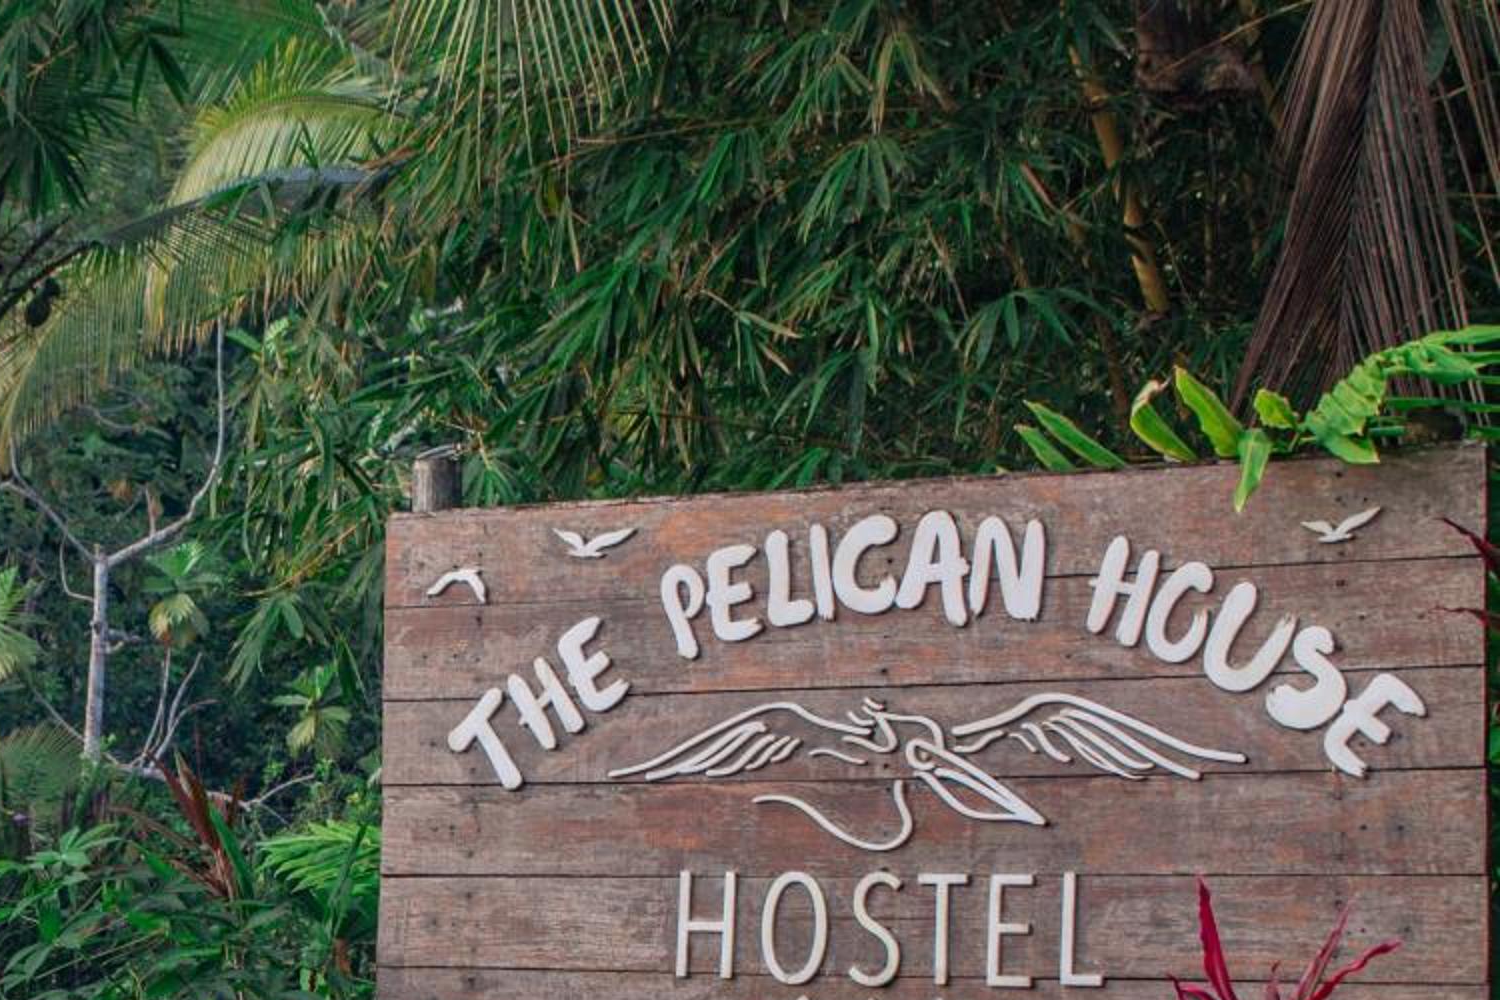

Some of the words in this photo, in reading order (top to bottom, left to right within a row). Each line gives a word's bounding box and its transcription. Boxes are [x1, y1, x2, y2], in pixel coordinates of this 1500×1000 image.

[445, 613, 631, 791] THE
[658, 508, 1046, 660] PELICAN
[1084, 533, 1426, 778] HOUSE
[674, 866, 1104, 988] HOSTEL
